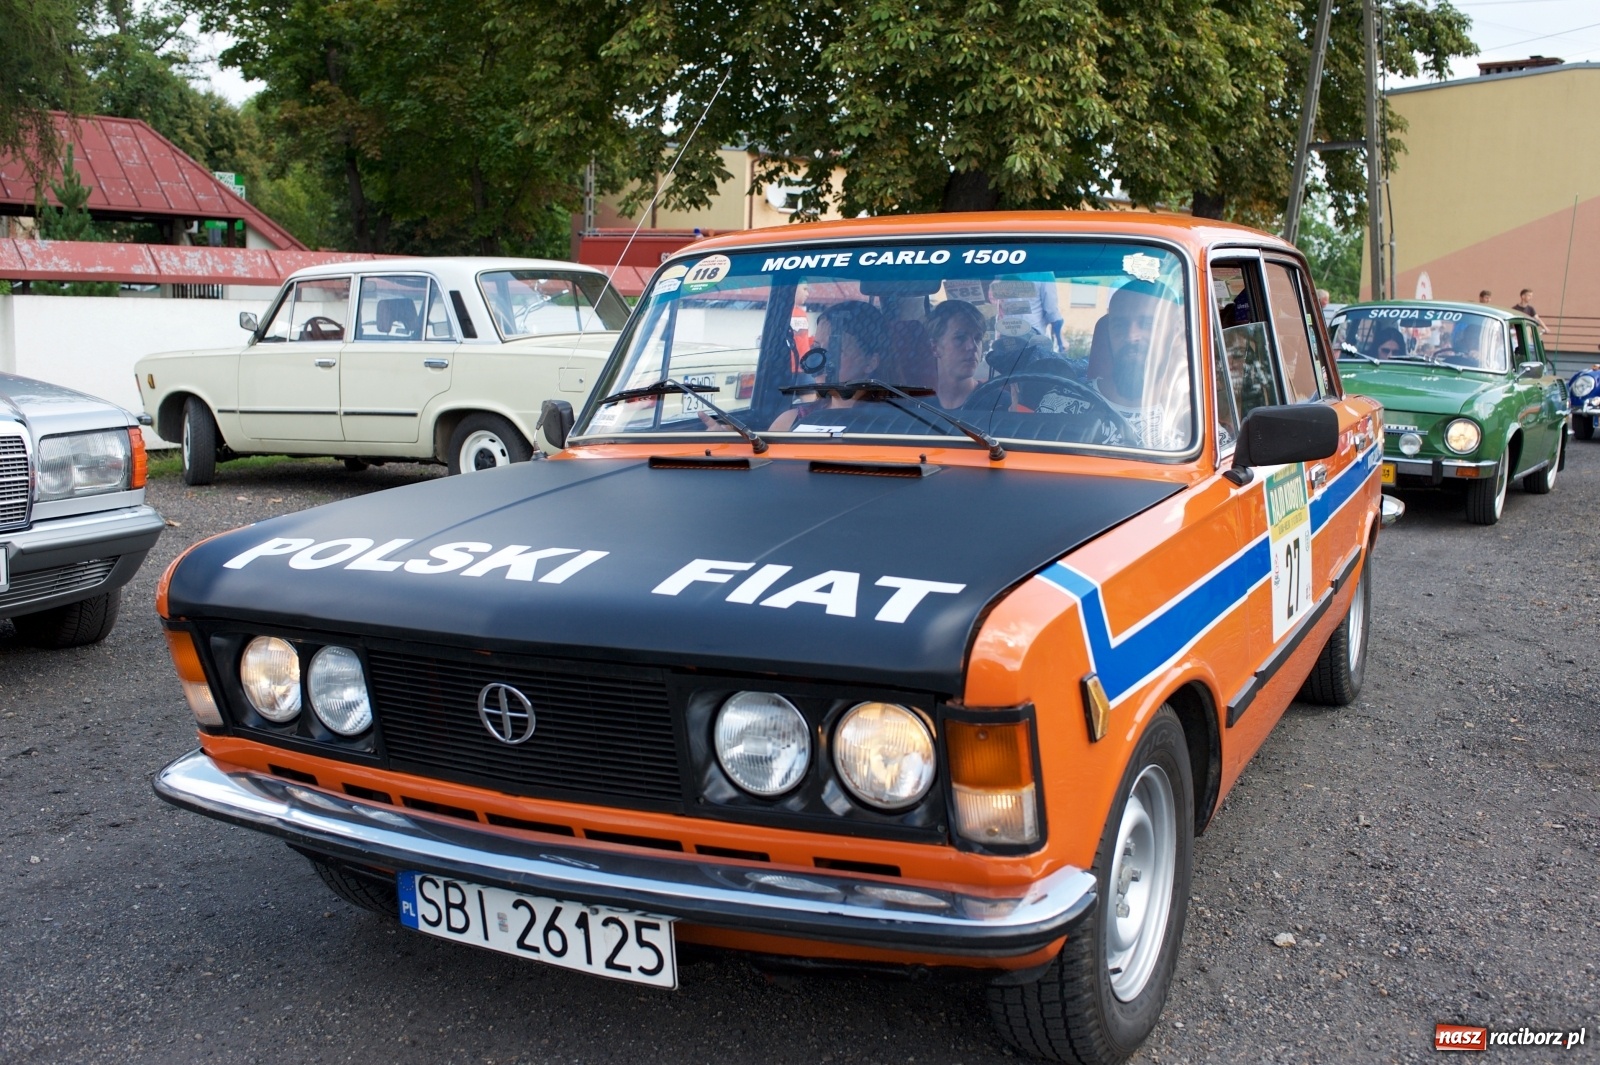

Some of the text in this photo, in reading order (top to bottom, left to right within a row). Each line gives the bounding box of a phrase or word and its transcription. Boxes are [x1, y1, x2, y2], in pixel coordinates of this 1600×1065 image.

[761, 249, 1026, 271] MONTE CARLO 1500
[692, 267, 720, 281] 118
[1368, 308, 1463, 322] SKODA S100
[222, 537, 967, 624] POLSKI FIAT
[1285, 537, 1300, 620] 27
[401, 900, 416, 918] PL
[418, 874, 665, 977] SBI 26125
